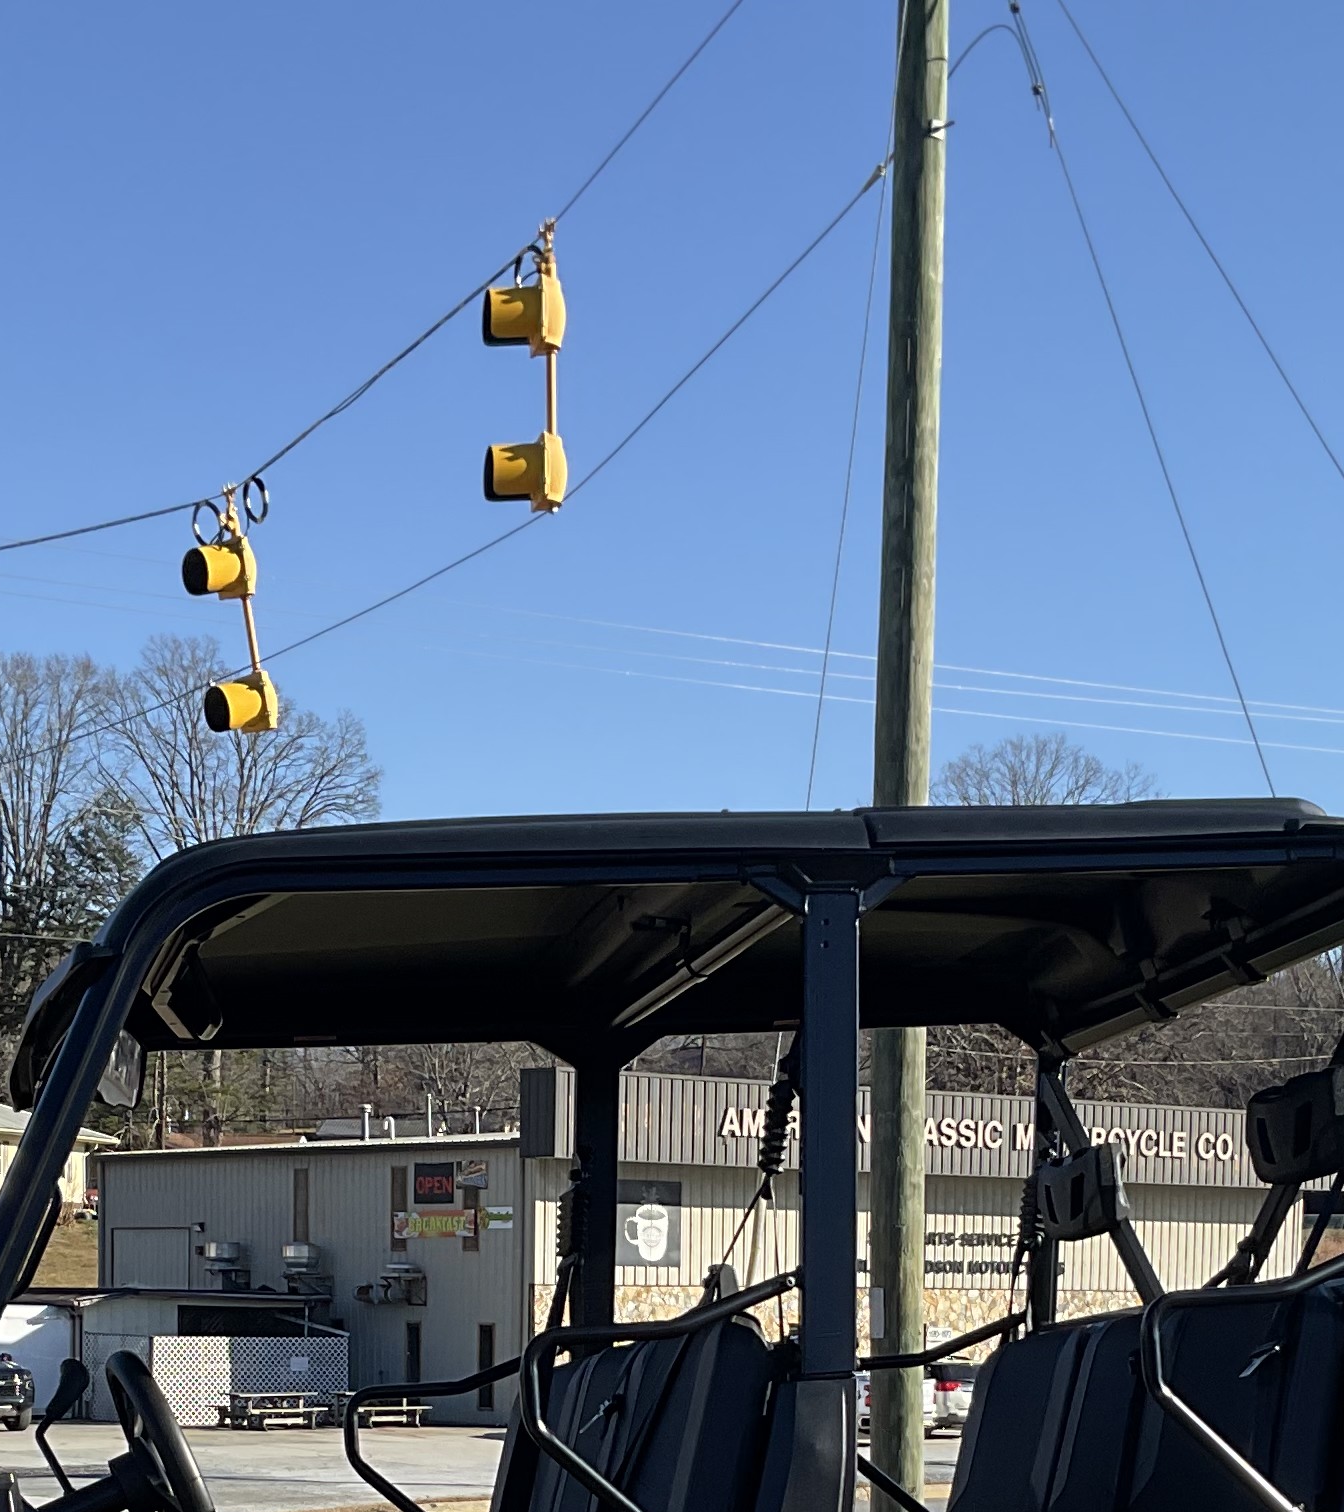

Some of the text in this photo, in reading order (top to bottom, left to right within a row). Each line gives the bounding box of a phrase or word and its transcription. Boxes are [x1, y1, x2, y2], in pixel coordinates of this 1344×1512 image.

[923, 1117, 1004, 1149] ASSIC
[1198, 1132, 1239, 1161] CO.
[415, 1174, 453, 1195] OPEN
